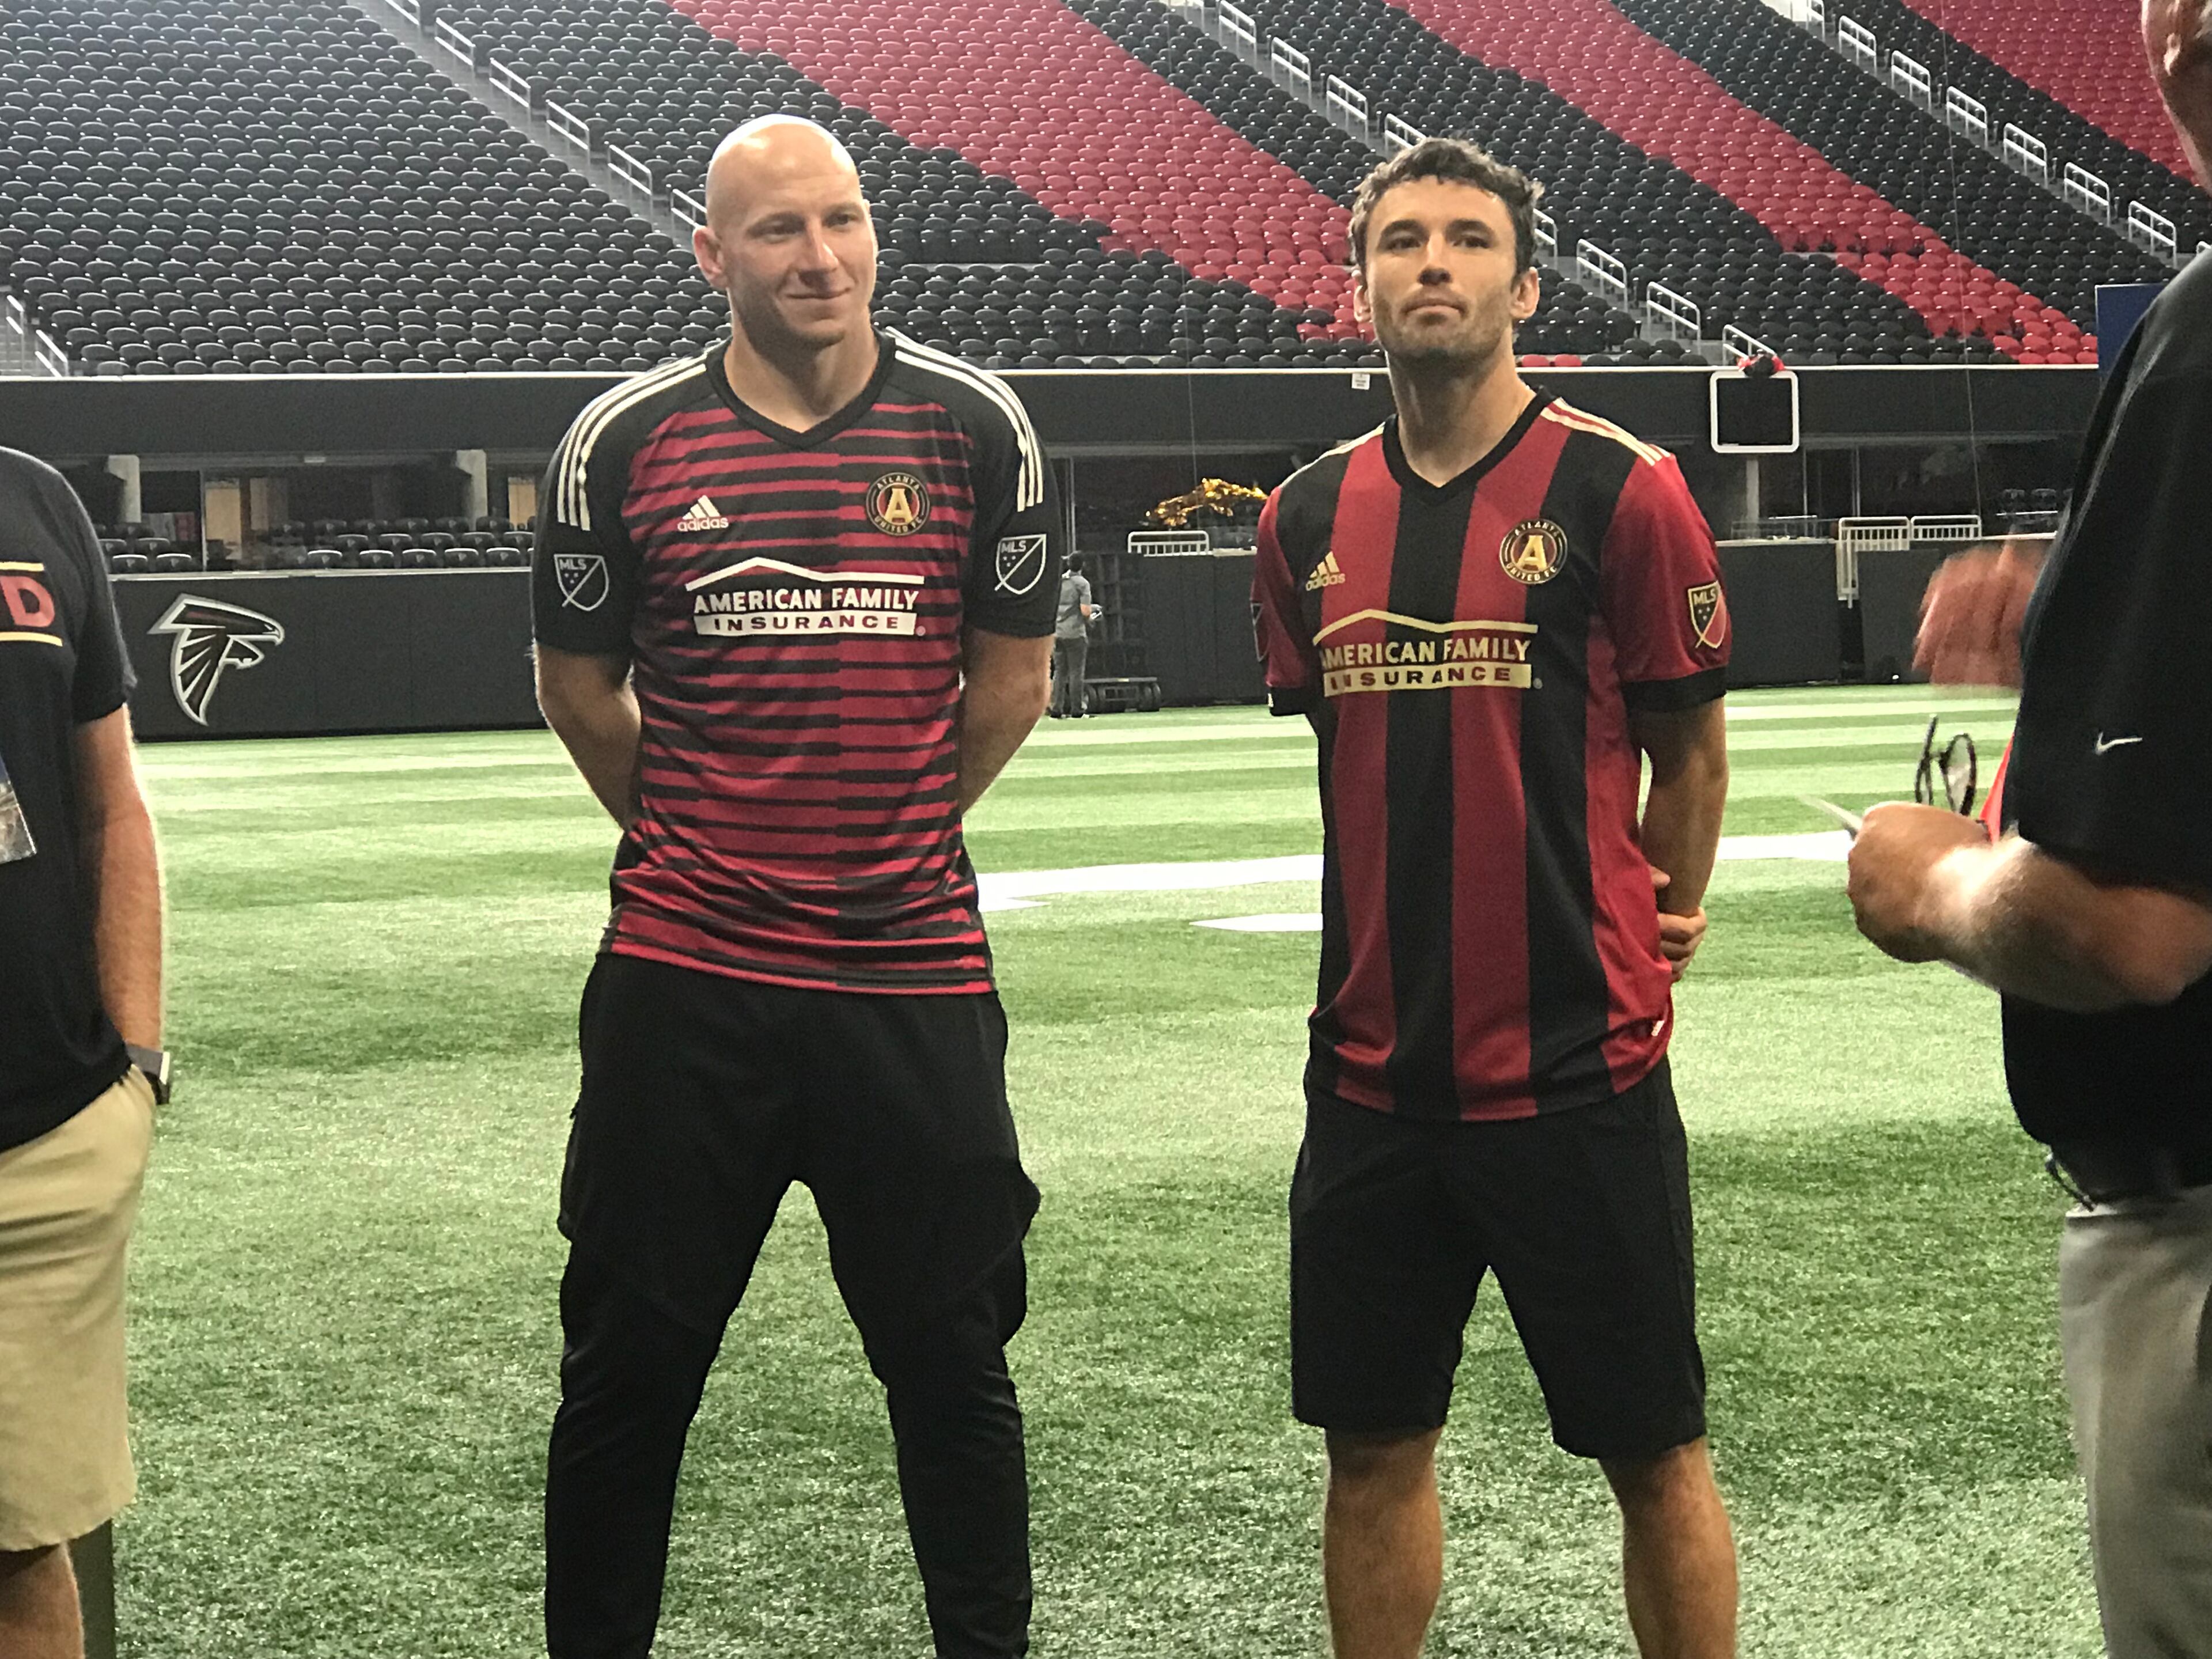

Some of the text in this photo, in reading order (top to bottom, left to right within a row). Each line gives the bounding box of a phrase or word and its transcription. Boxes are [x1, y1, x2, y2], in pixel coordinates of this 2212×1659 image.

[877, 475, 919, 490] ATLANTA
[677, 517, 729, 531] adidas
[1000, 540, 1027, 553] MLS
[559, 559, 586, 570] MLS
[1305, 573, 1346, 591] adidas
[694, 588, 919, 613] AMERICAN FAMILY
[1694, 589, 1716, 605] MLS
[714, 615, 899, 631] INSURANCE
[1444, 637, 1531, 661] FAMILY
